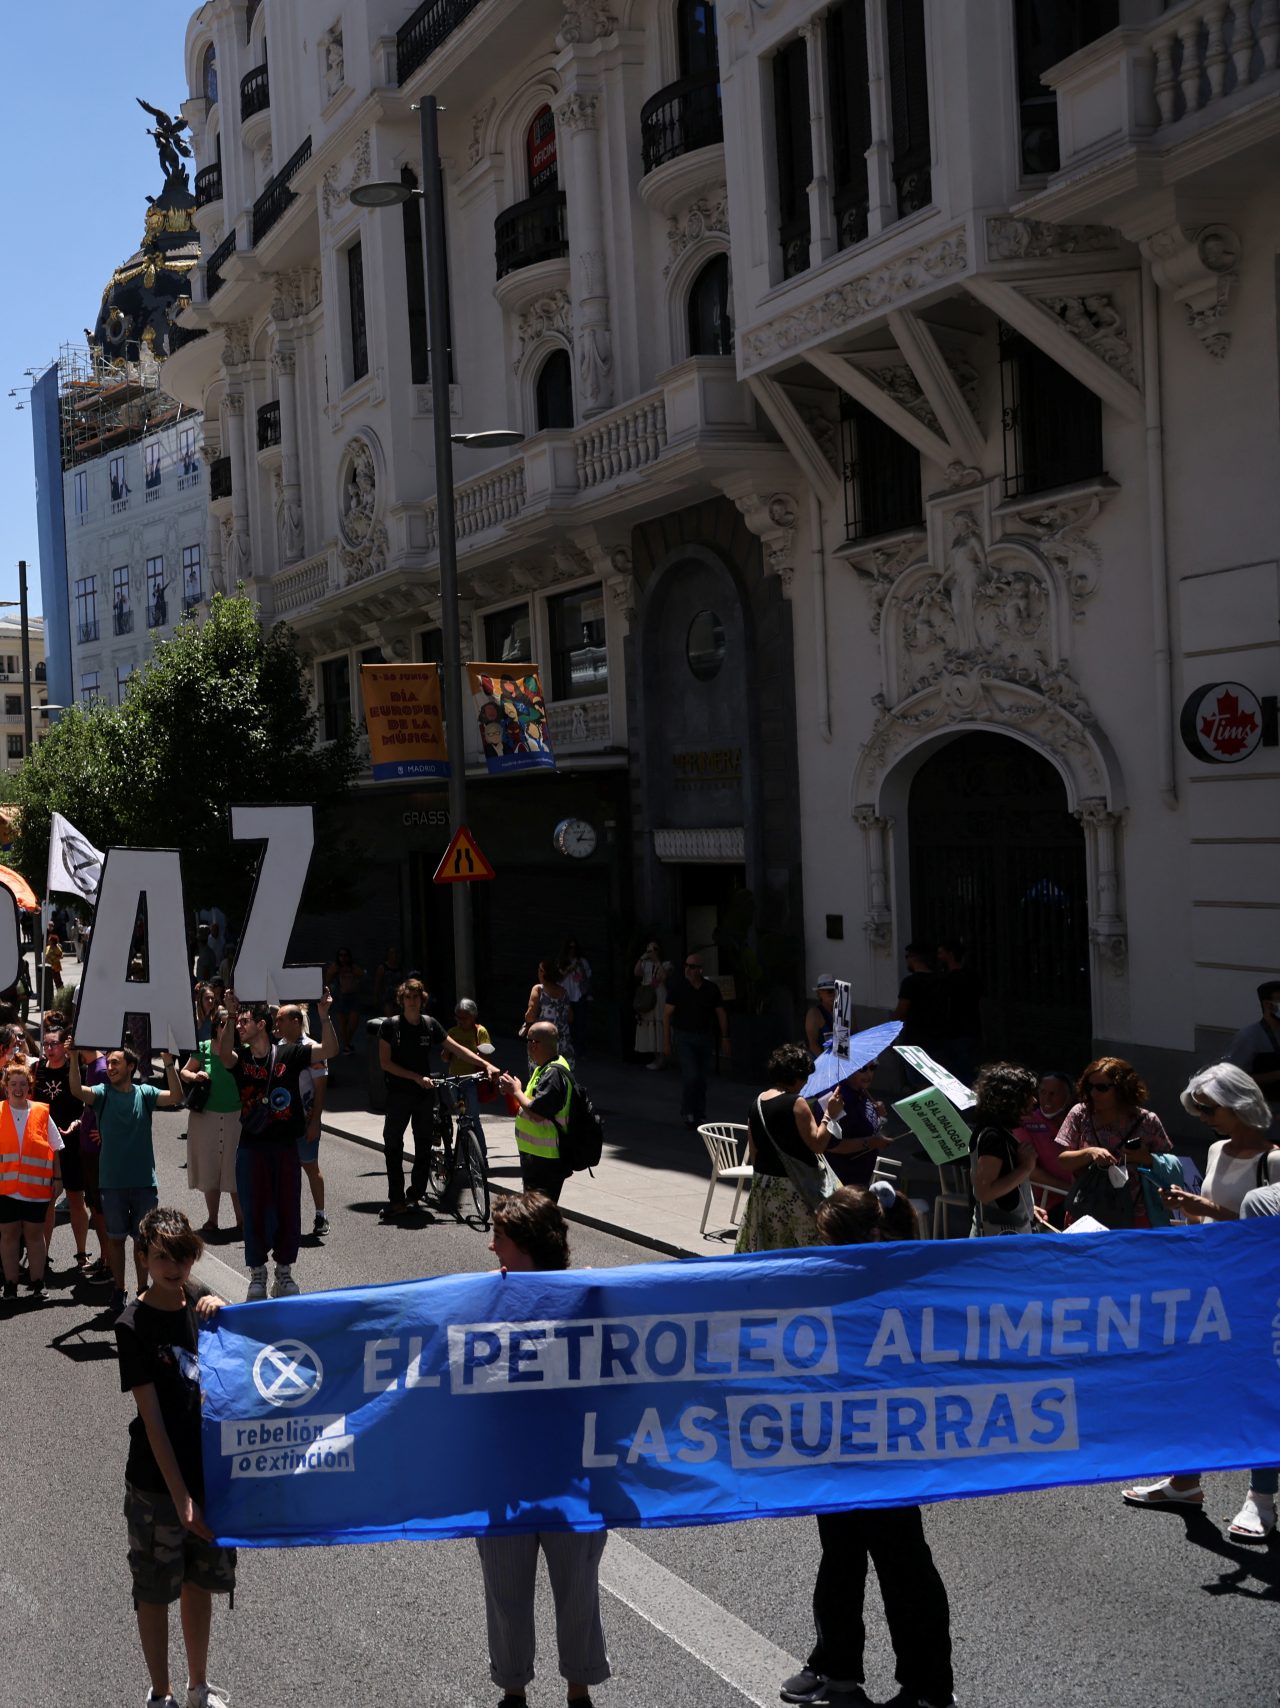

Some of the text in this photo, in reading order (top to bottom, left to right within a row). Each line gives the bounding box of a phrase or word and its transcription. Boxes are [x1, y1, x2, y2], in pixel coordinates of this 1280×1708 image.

[390, 688, 418, 702] DÍA
[388, 718, 432, 730] DE LA
[1206, 713, 1252, 744] Tims
[381, 730, 439, 745] MÚSICA
[407, 765, 436, 773] MADRID
[909, 1101, 922, 1112] NO
[364, 1336, 440, 1393] EL
[462, 1314, 831, 1387] PETROLEO
[865, 1285, 1232, 1368] ALIMENTA
[236, 1419, 323, 1446] rebelión
[582, 1386, 1068, 1468] LAS GUERRAS
[255, 1446, 349, 1471] extinción
